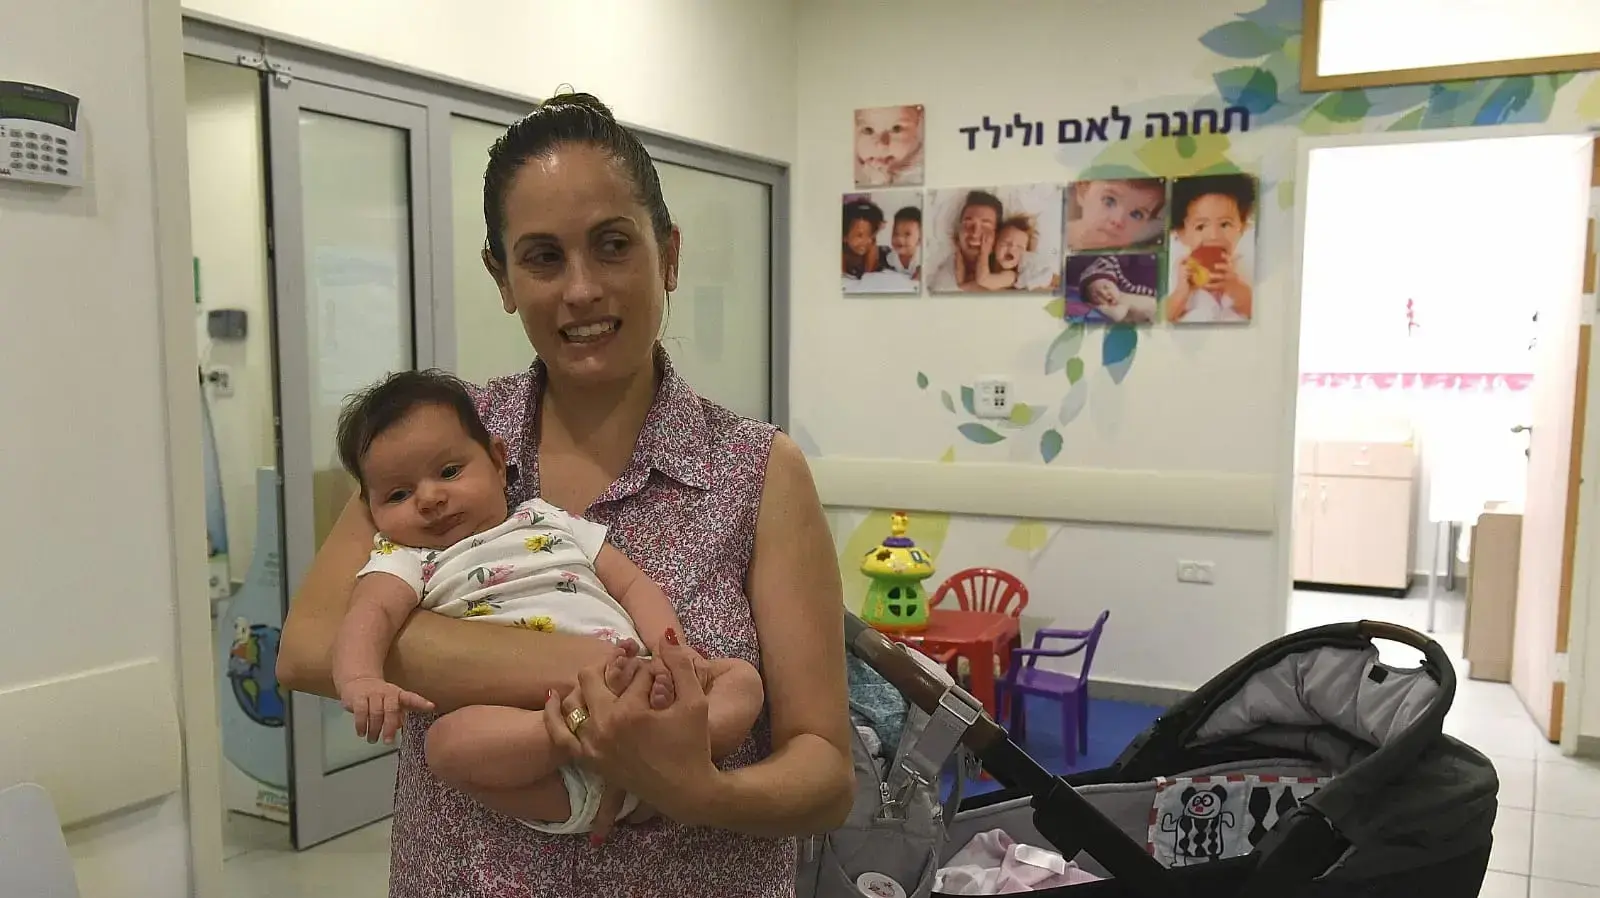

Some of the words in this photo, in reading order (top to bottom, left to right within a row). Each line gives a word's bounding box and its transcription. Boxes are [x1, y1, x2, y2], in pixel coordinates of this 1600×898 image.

[959, 113, 1044, 151] ולילד
[1058, 105, 1132, 144] לאם
[1145, 105, 1250, 139] תחנה
